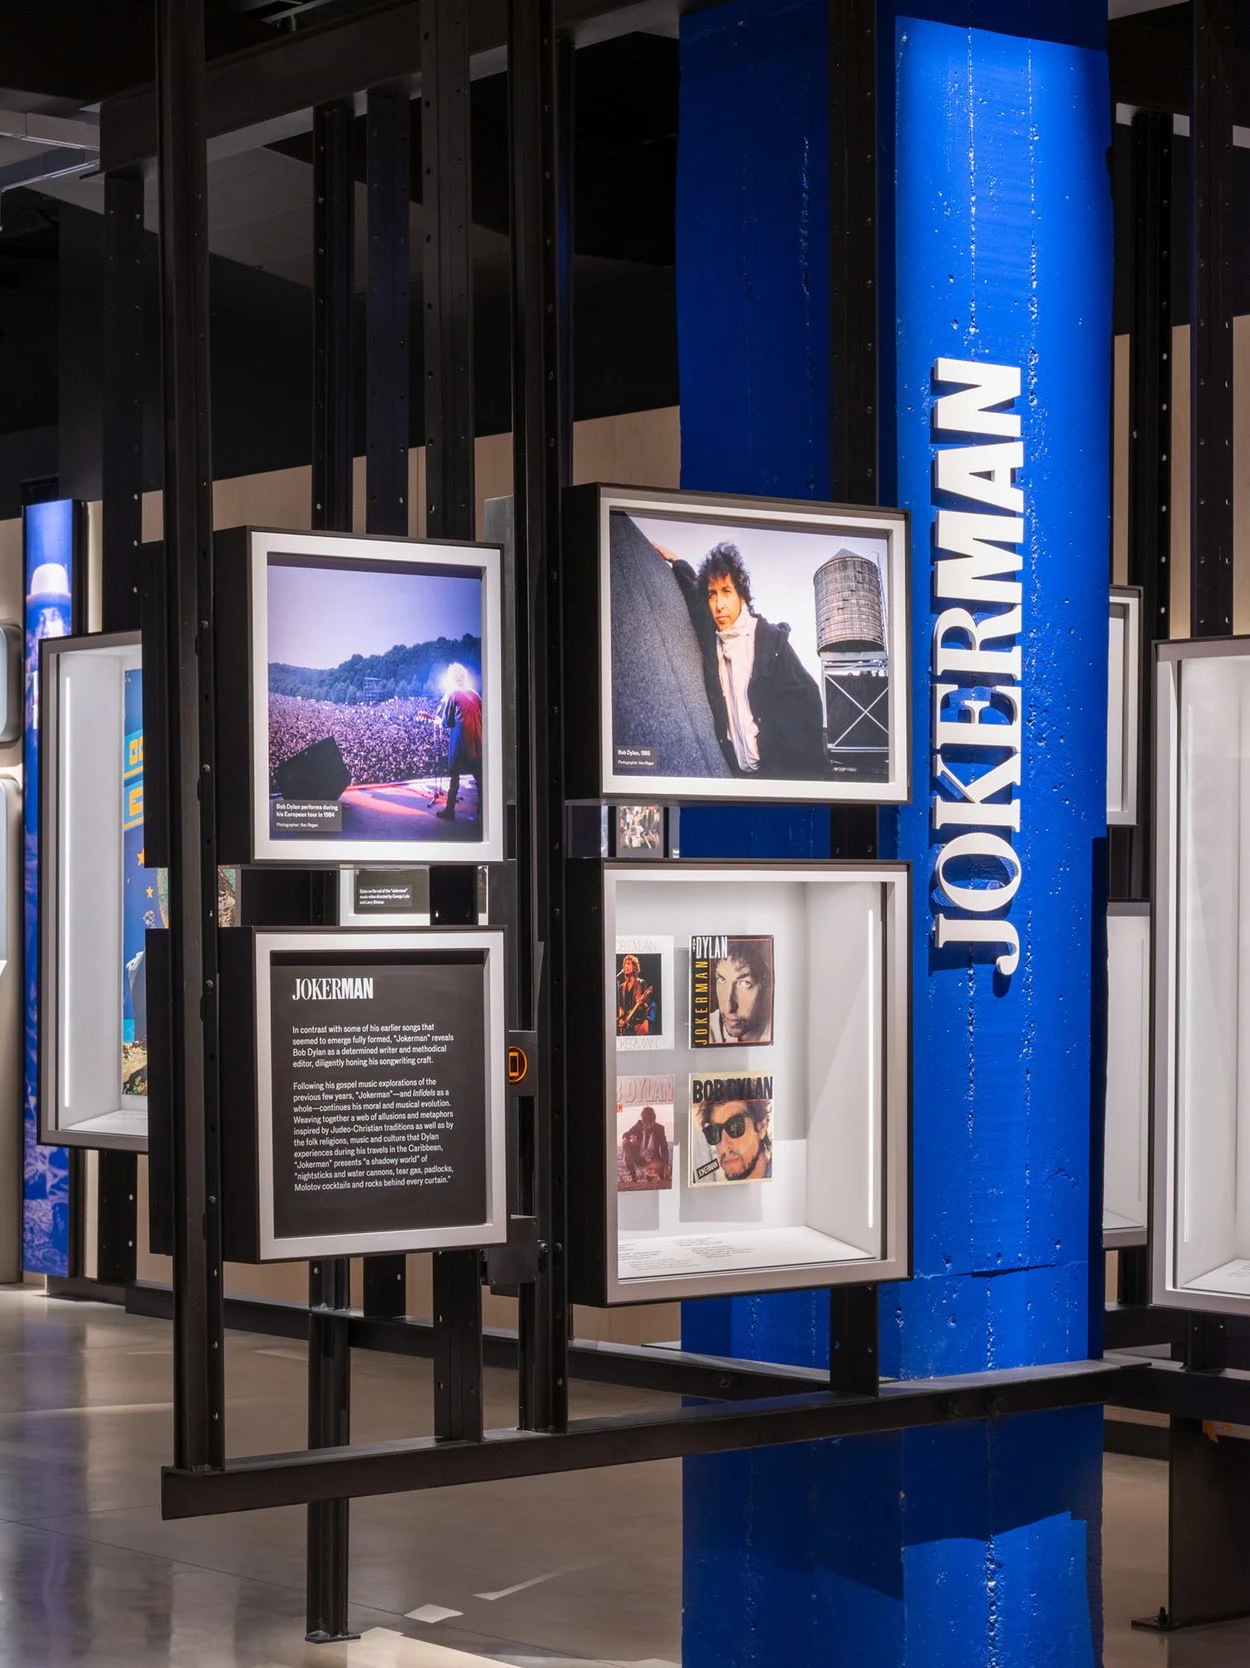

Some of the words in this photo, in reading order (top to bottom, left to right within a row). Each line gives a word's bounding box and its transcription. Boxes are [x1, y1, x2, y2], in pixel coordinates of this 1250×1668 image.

[934, 358, 1024, 976] JOKERMAN
[627, 940, 657, 952] DYLAN
[696, 936, 727, 959] DYLAN
[293, 978, 373, 999] JOKERMAN
[695, 961, 708, 1045] JOKERMAN
[353, 1036, 366, 1044] fully
[308, 1048, 326, 1057] Dylan
[315, 1059, 344, 1068] diligently
[346, 1058, 368, 1067] honing
[379, 1057, 416, 1066] songwriting
[294, 1082, 324, 1090] Following
[336, 1081, 357, 1090] gospel
[378, 1079, 417, 1087] explorations
[625, 1076, 674, 1102] DYLAN
[693, 1079, 724, 1103] BOB
[726, 1076, 773, 1101] DYLAN
[294, 1094, 321, 1102] previous
[356, 1090, 411, 1098] "Jokerman"—and
[698, 1160, 719, 1178] JOKERMAN
